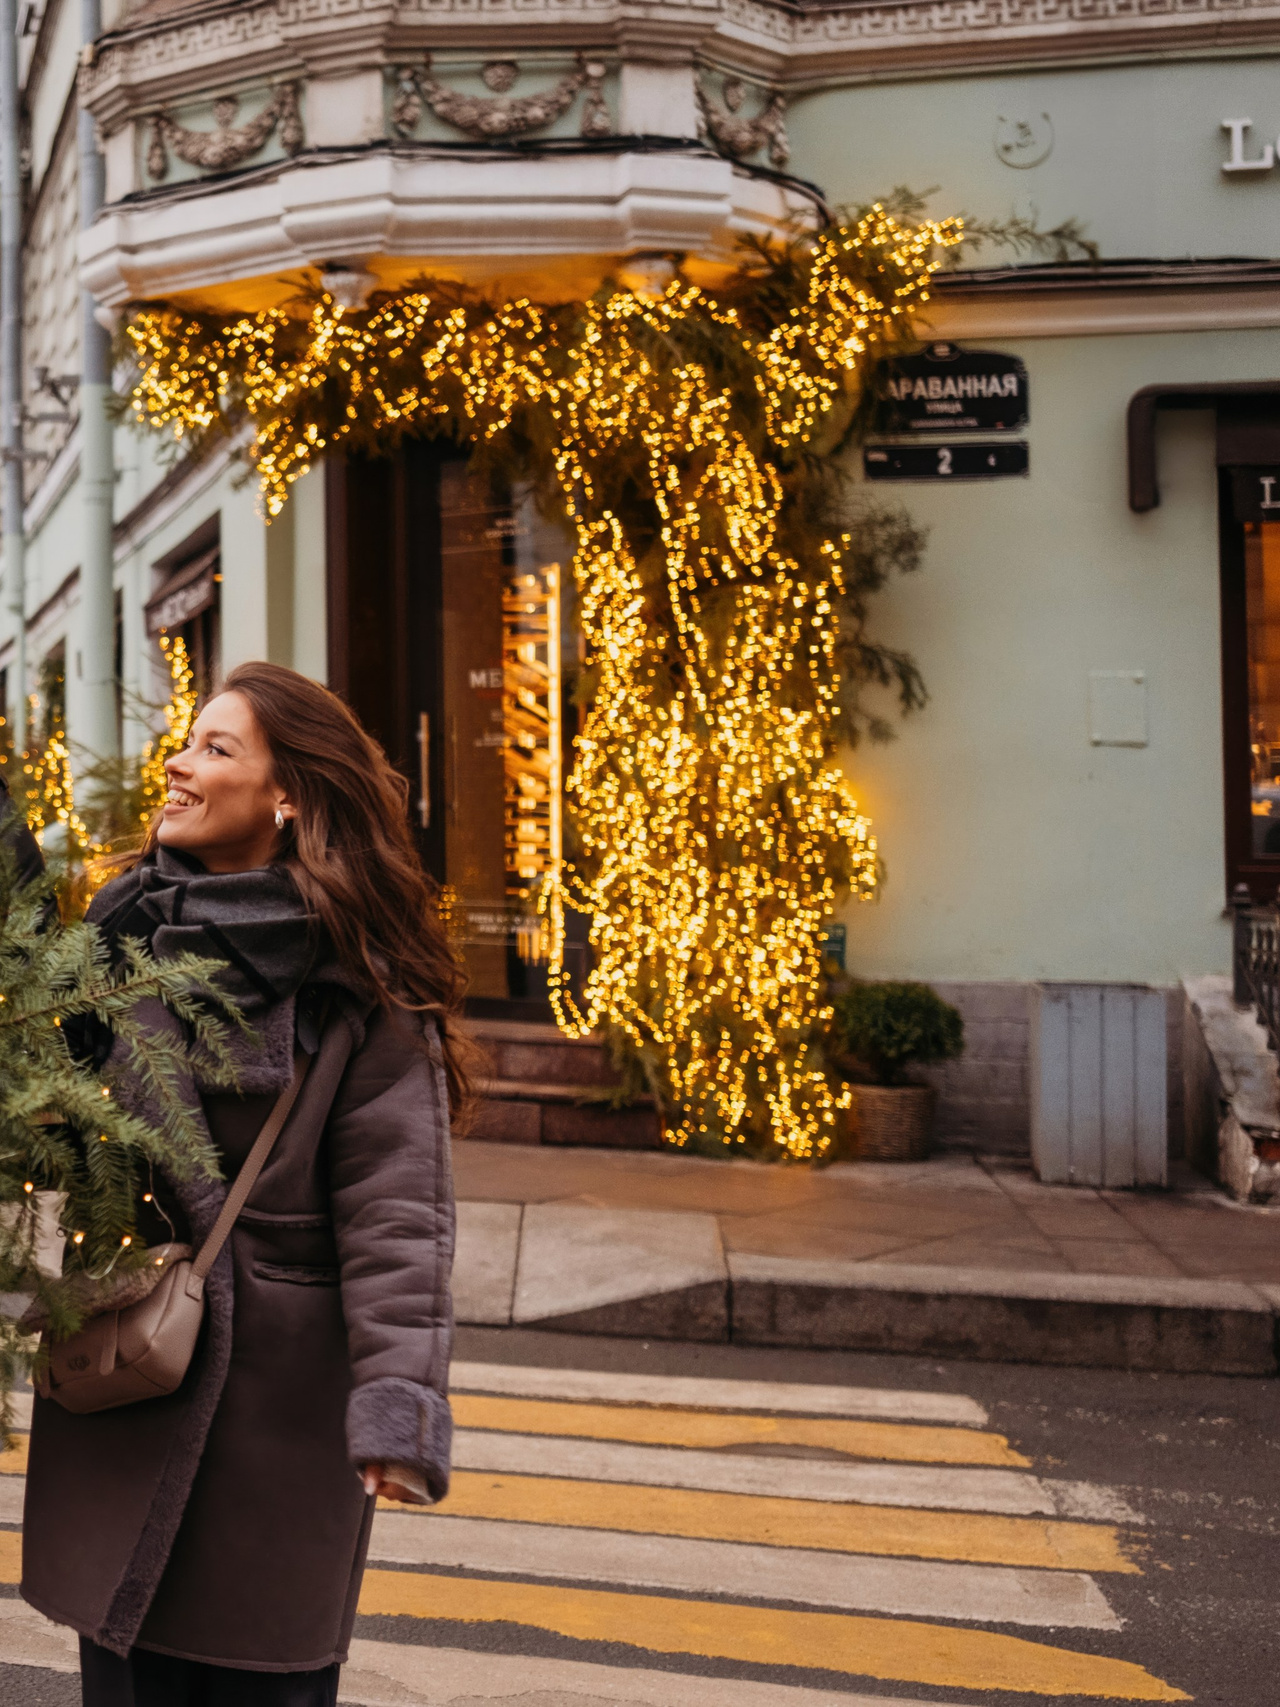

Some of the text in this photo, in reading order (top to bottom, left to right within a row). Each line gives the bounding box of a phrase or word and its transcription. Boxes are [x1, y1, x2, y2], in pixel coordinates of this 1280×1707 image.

[1222, 118, 1280, 171] L
[881, 373, 1018, 401] АРАВАННАЯ
[937, 448, 953, 475] 2
